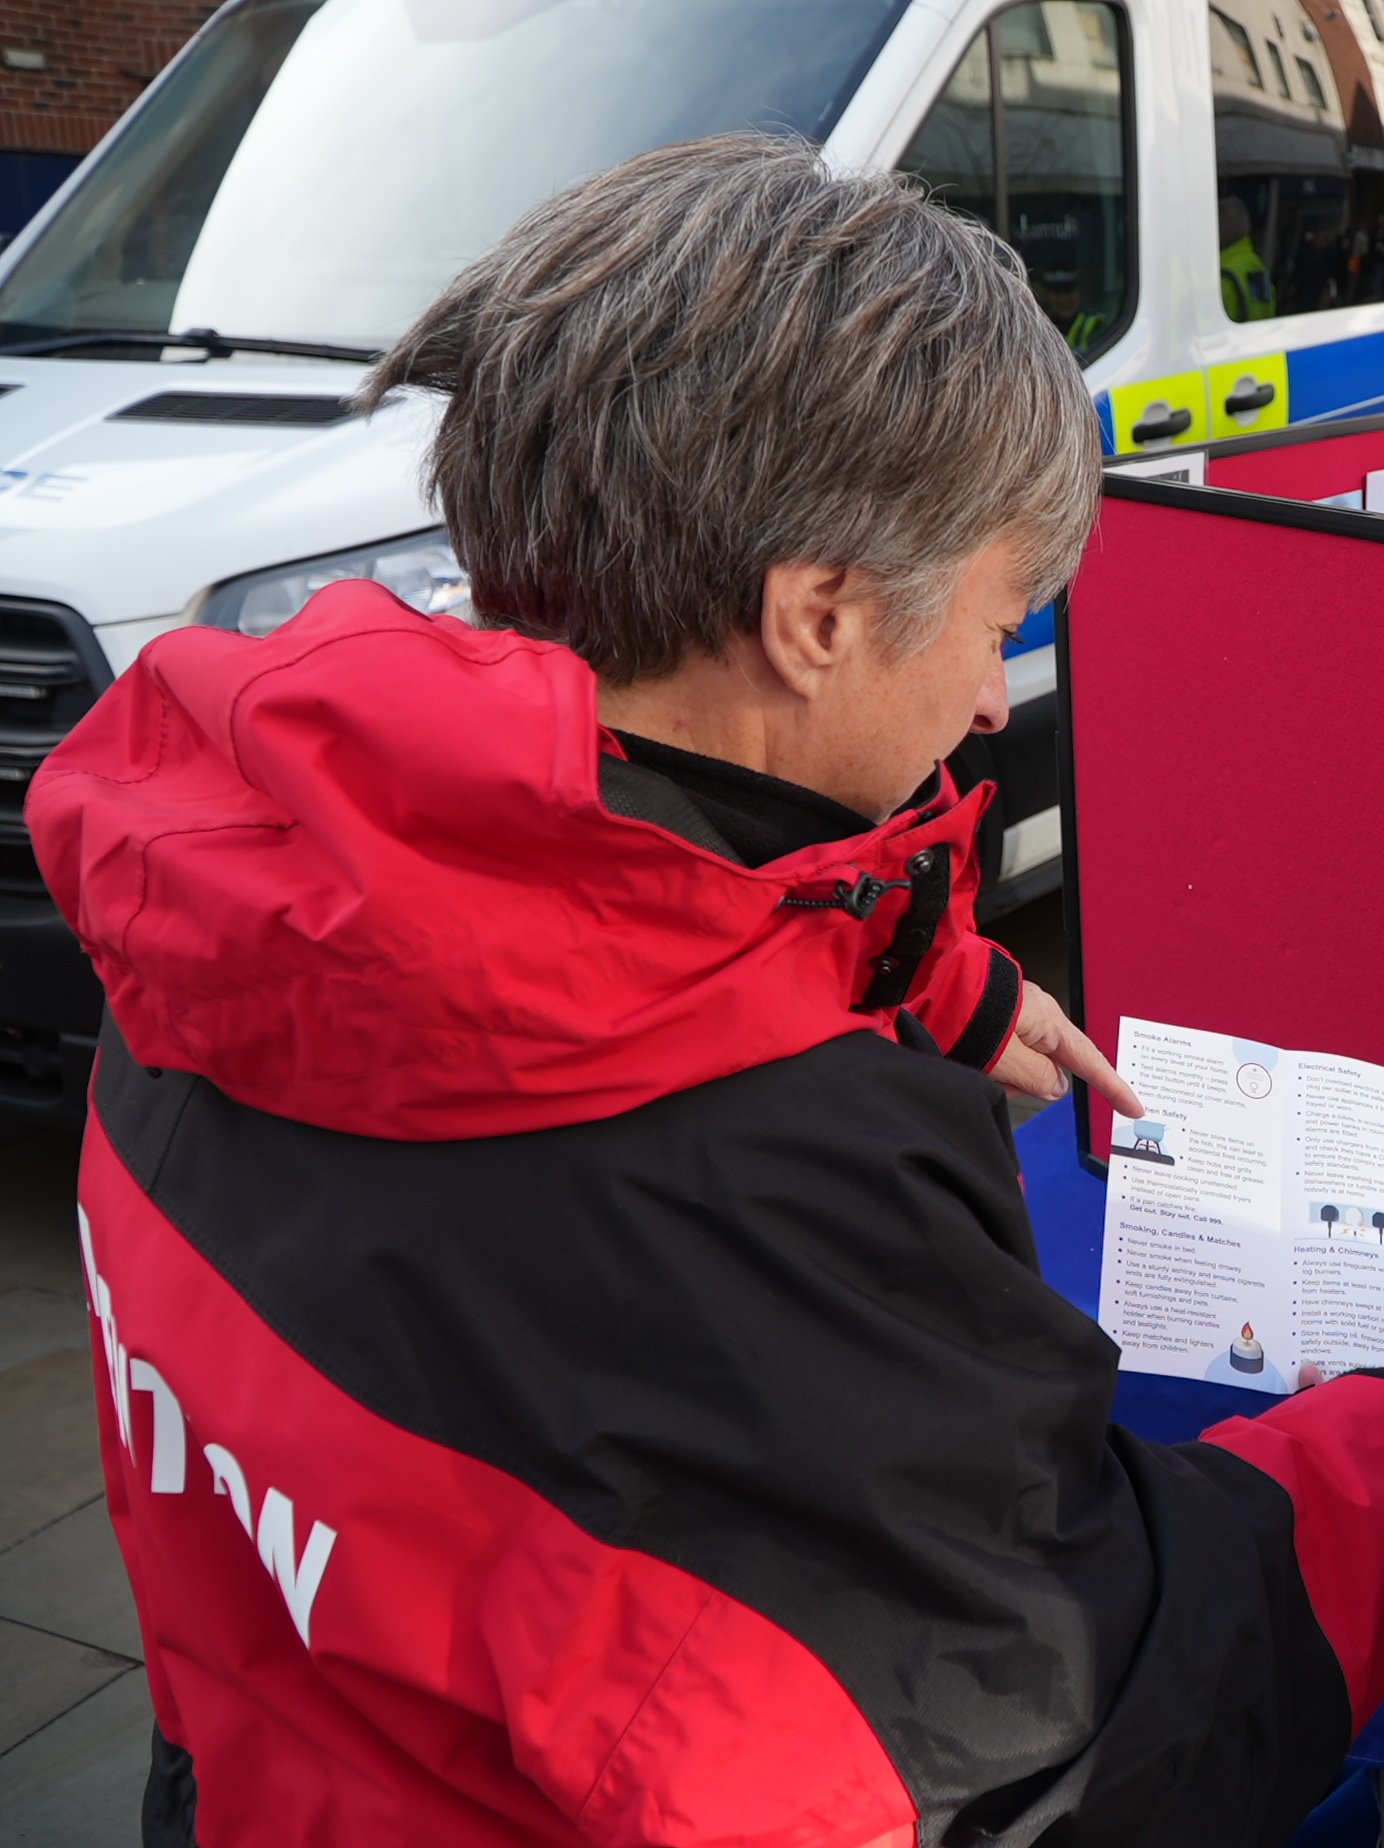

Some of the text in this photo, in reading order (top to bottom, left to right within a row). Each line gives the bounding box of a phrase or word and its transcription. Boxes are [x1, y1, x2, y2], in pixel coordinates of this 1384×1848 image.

[1162, 1109, 1187, 1121] Safety
[1161, 1229, 1196, 1240] Candles
[1207, 1236, 1241, 1248] Matches
[1294, 1246, 1327, 1254] Heating
[1337, 1247, 1379, 1259] Chimneys
